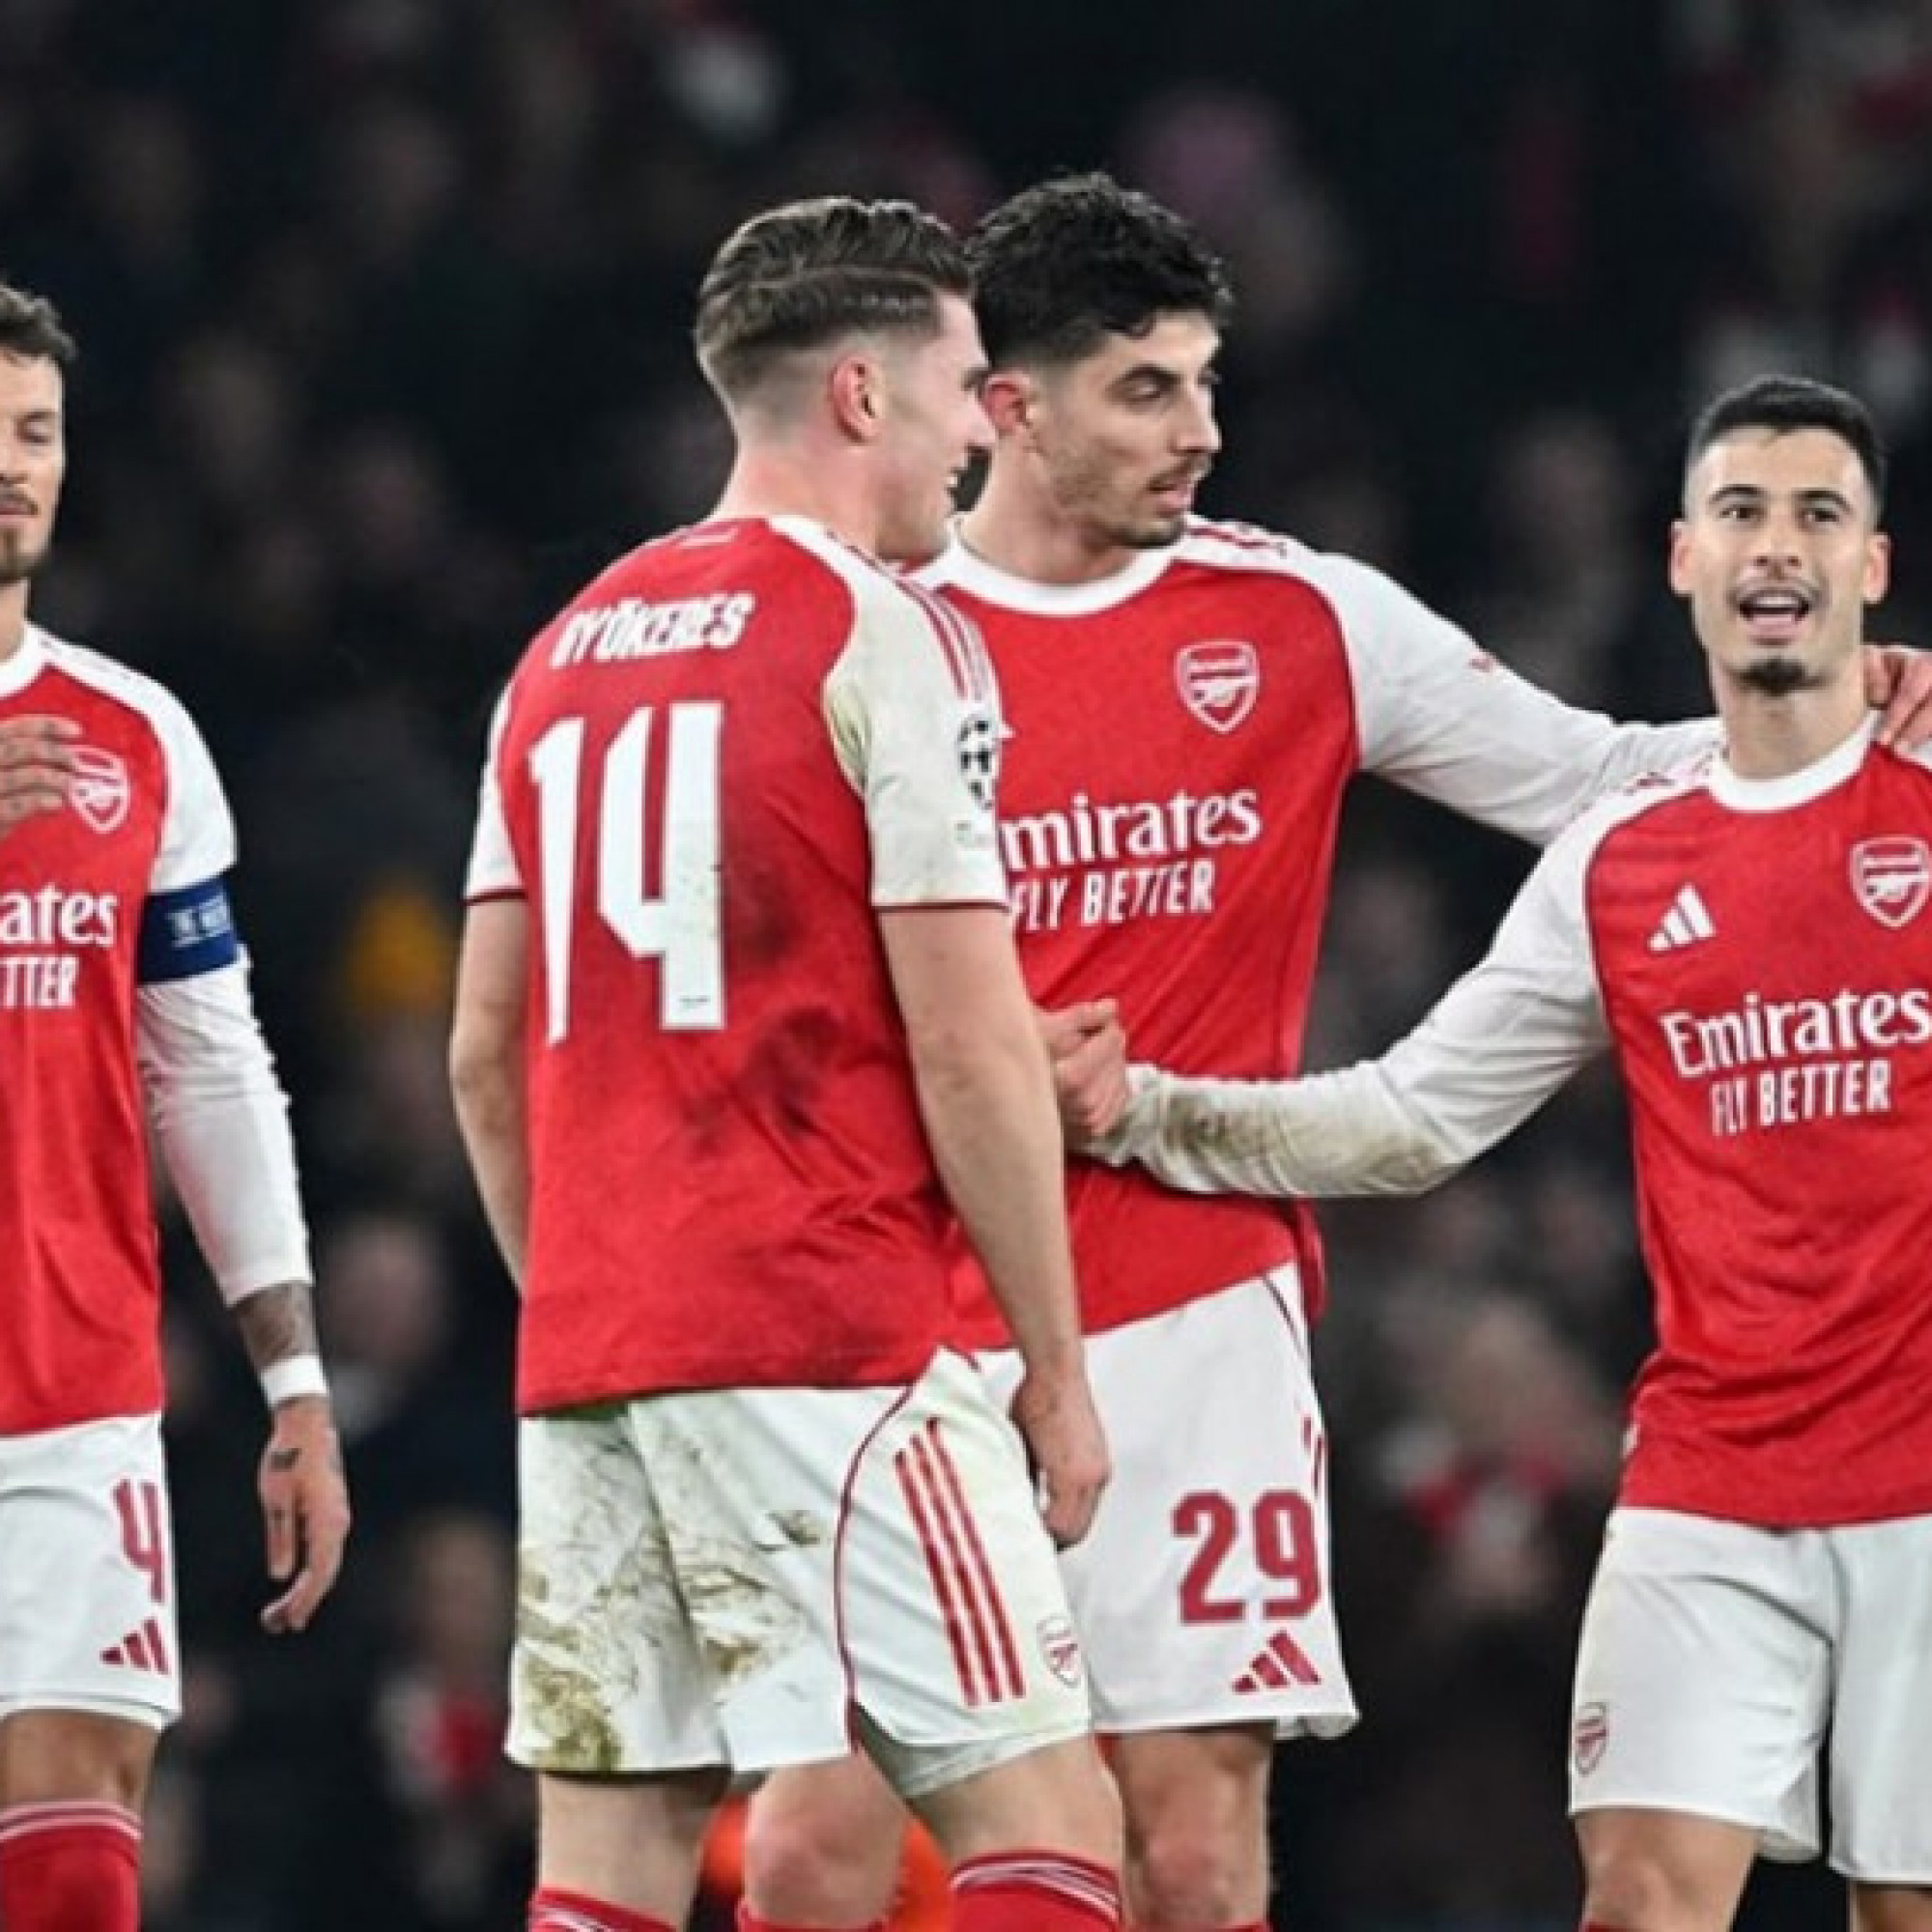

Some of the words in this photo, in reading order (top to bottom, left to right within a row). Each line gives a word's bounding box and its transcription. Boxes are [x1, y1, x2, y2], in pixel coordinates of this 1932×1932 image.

[528, 701, 724, 1045] 14
[1000, 788, 1262, 869] mirates
[1082, 858, 1213, 925] BETTER
[1659, 988, 1932, 1079] Emirates
[1759, 1059, 1890, 1126] BETTER
[113, 1478, 164, 1604] 4
[1172, 1489, 1321, 1625] 29
